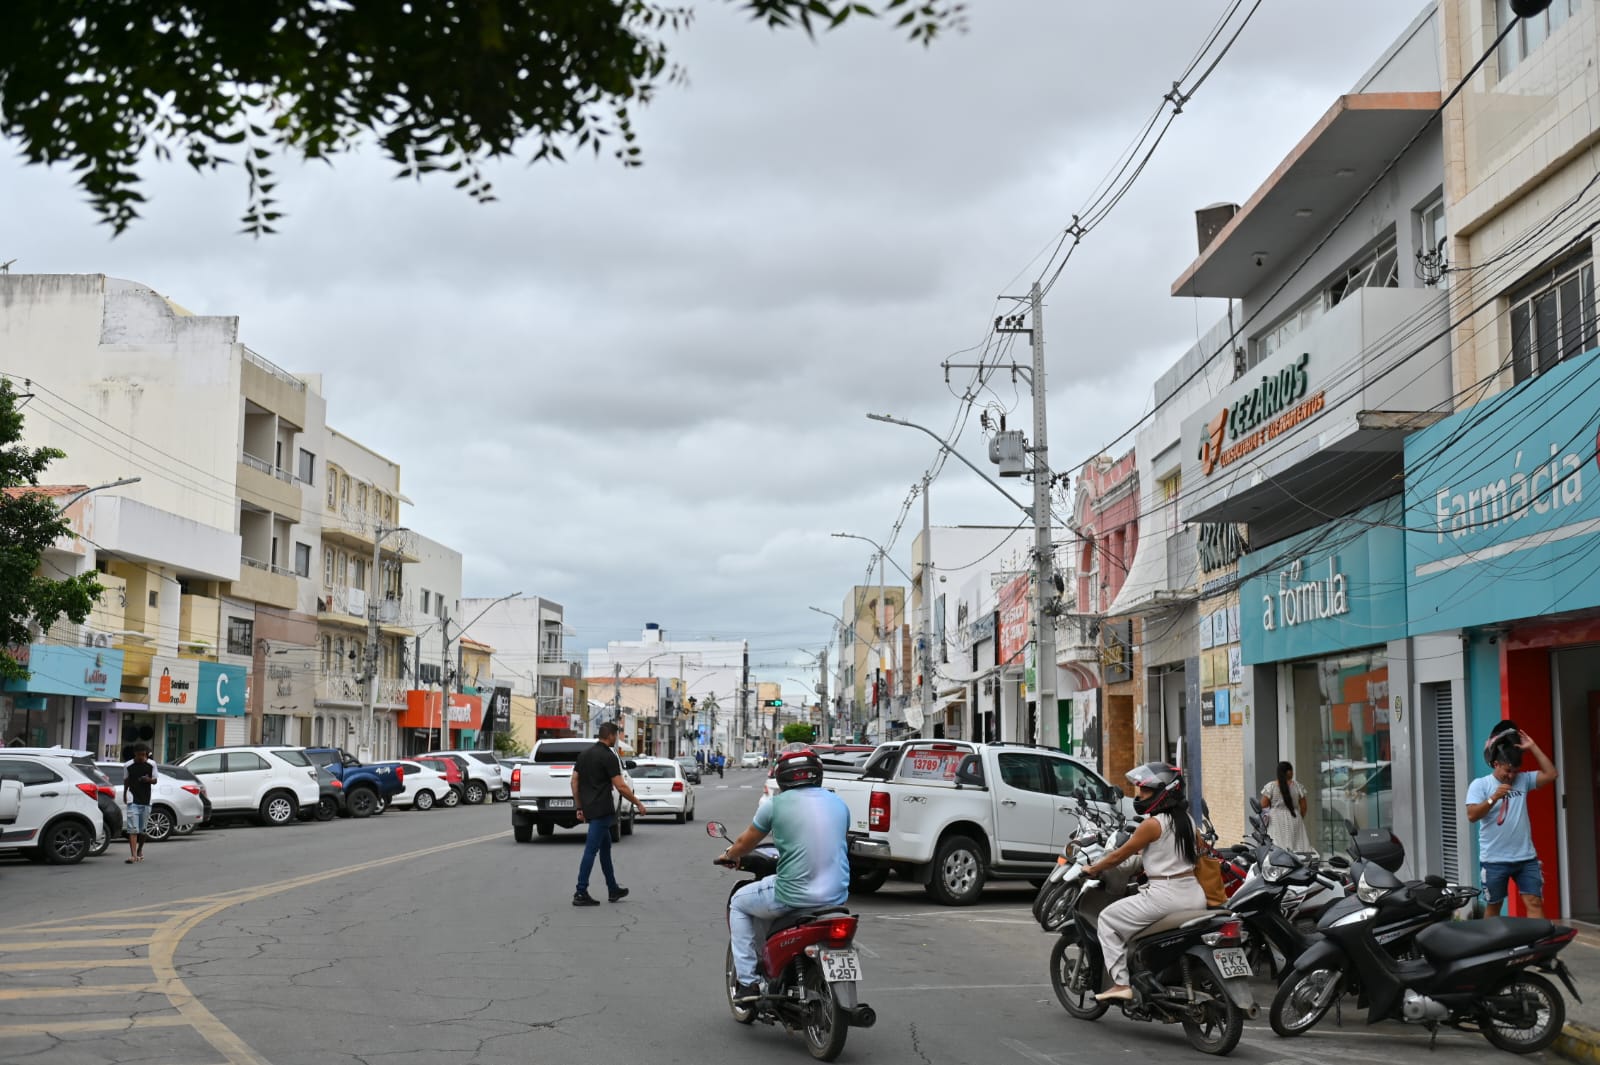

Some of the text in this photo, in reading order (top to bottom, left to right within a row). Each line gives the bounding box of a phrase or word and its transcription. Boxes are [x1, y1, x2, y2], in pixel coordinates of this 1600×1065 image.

[1436, 442, 1583, 545] Farmácia
[1263, 593, 1277, 631] a
[913, 759, 937, 771] 13789
[829, 968, 858, 980] 4297
